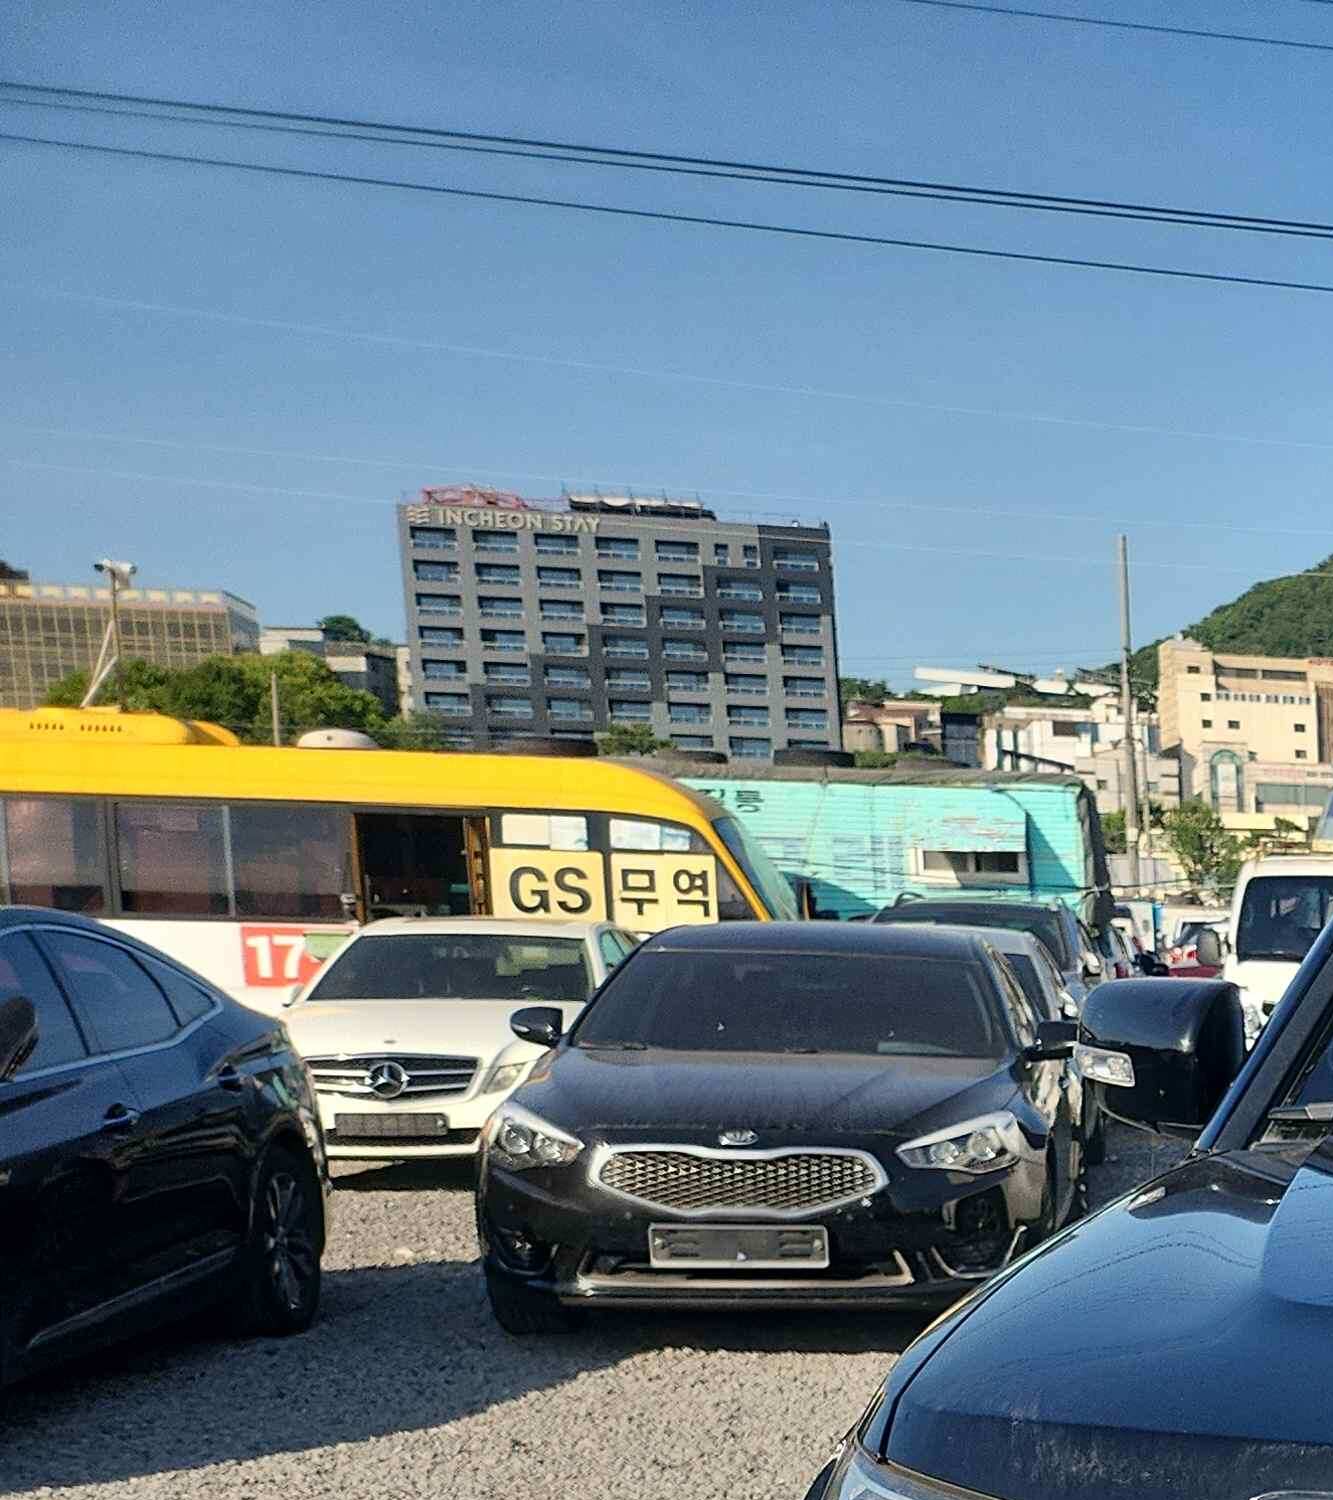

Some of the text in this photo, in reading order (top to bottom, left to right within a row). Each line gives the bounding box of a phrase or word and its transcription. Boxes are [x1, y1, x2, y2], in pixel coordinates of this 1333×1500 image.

[438, 509, 600, 533] INCHEON STAY
[509, 866, 710, 917] GS 무역
[246, 935, 305, 979] 17
